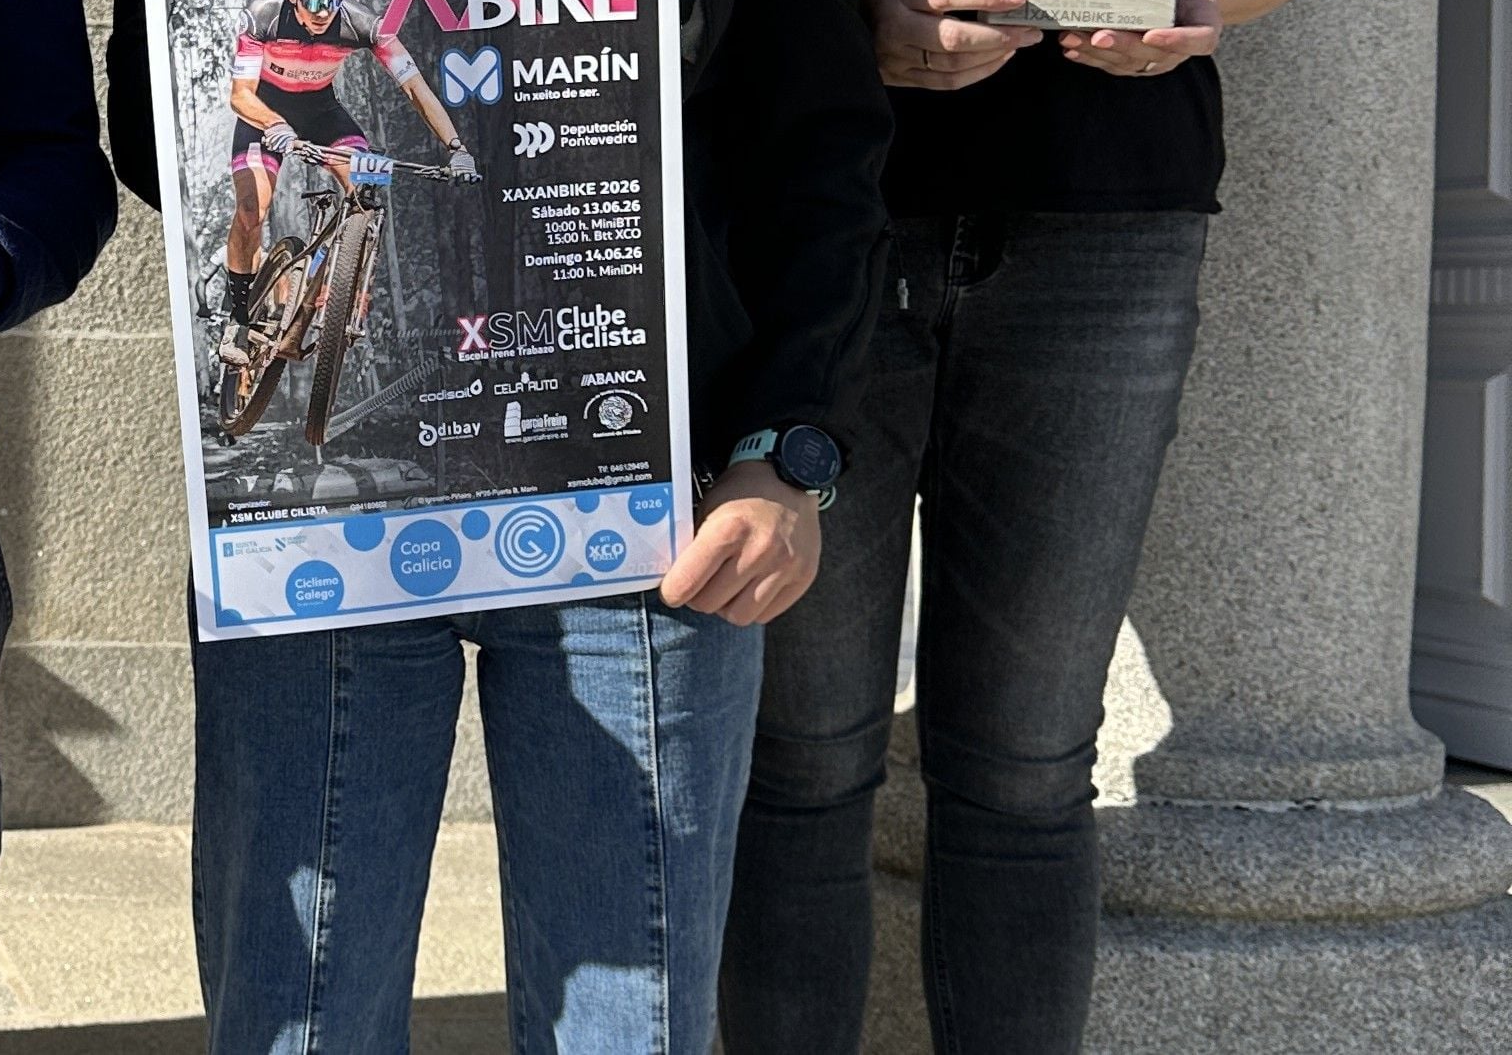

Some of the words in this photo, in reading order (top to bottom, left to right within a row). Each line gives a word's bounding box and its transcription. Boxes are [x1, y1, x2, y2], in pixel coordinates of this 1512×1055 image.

[512, 46, 639, 87] MARÍN
[514, 91, 531, 102] Un
[532, 89, 560, 101] xeito
[562, 88, 578, 99] de
[579, 87, 600, 98] ser.
[560, 119, 637, 136] Deputación
[560, 134, 637, 148] Pontevedra
[502, 182, 596, 202] XAXANBIKE
[600, 179, 640, 195] 2026
[531, 204, 580, 220] Sábado
[583, 200, 641, 216] 13.06.26
[545, 221, 576, 234] 10:00
[591, 216, 641, 230] MiniBTT
[547, 232, 579, 245] 15:00
[594, 230, 613, 241] Btt
[615, 228, 641, 240] XCO
[525, 252, 582, 268] Domingo
[585, 246, 642, 262] 14.06.26
[553, 268, 585, 281] 11:00
[599, 264, 642, 276] MiniDH
[556, 304, 626, 329] Clube
[456, 308, 554, 352] XSM
[557, 324, 647, 351] Ciclista
[438, 421, 481, 437] dibay
[635, 500, 662, 511] 2026
[230, 513, 253, 524] XSM
[255, 510, 288, 522] CLUBE
[290, 506, 328, 518] CILISTA
[400, 540, 440, 556] Copa
[401, 557, 452, 575] Galicia
[294, 576, 338, 588] Ciclismo
[295, 588, 335, 602] Galego
